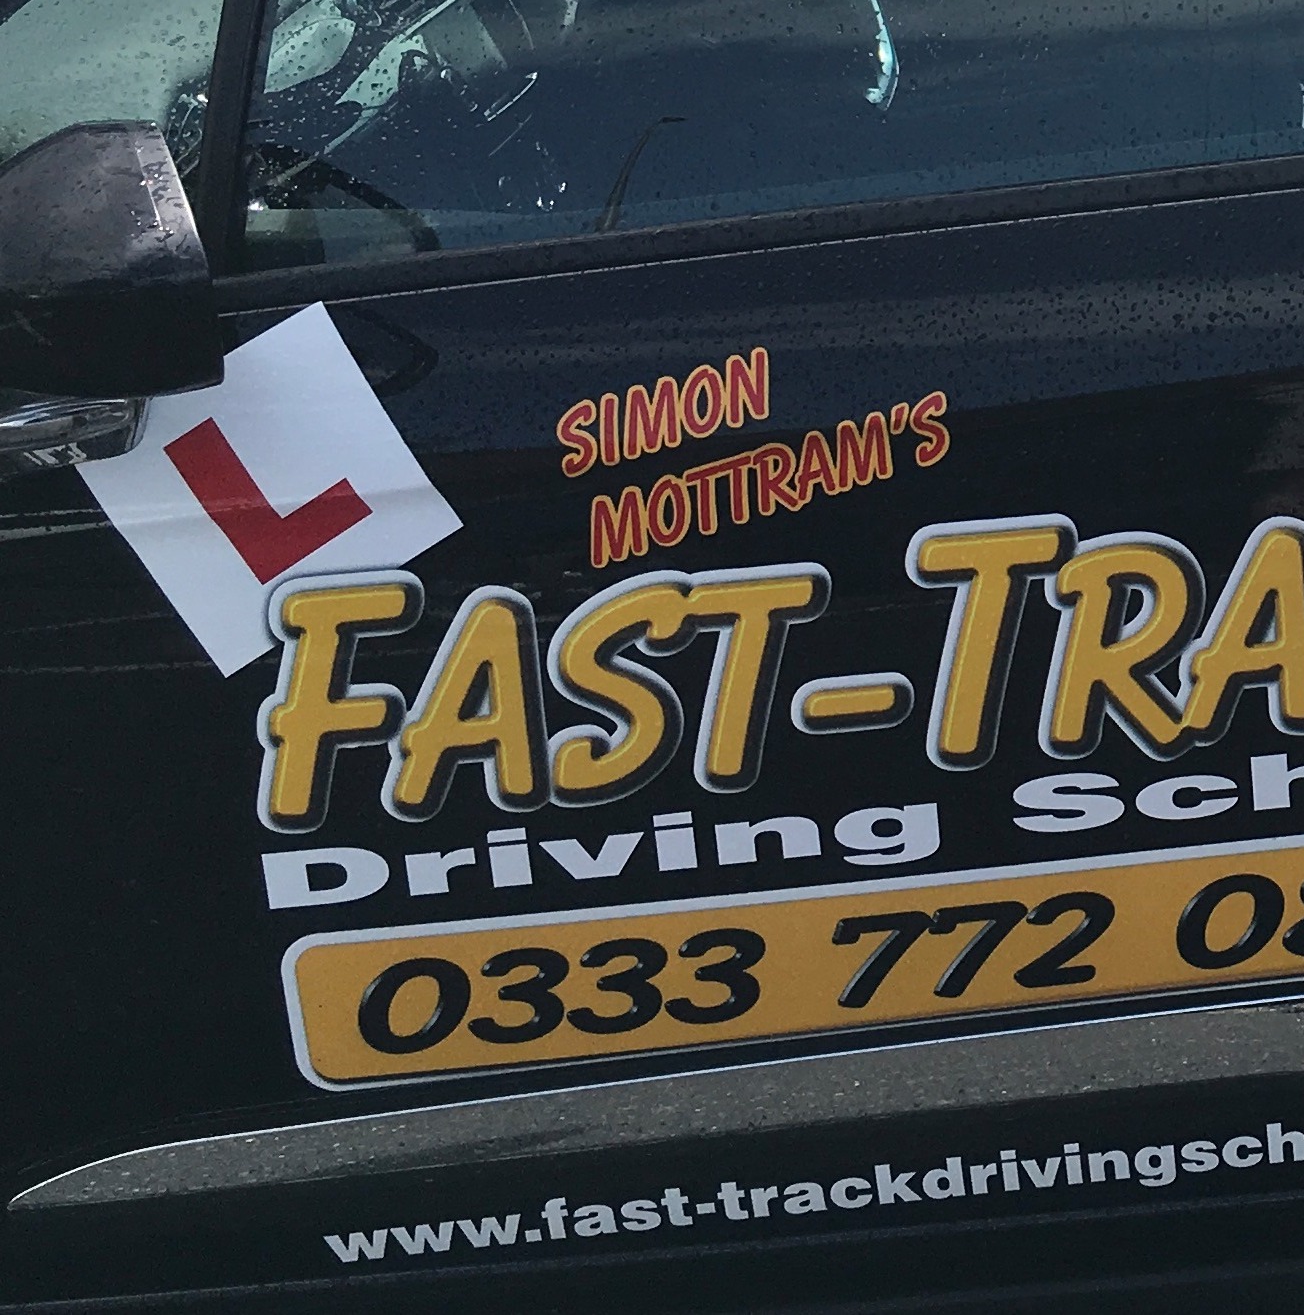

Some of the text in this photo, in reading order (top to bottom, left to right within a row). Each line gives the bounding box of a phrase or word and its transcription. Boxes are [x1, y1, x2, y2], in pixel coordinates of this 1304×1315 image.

[557, 346, 769, 478] SIMON
[591, 391, 950, 568] MOTTRAM'S
[163, 417, 373, 585] L
[261, 802, 940, 909] Driving
[357, 928, 766, 1055] 0333
[832, 892, 1115, 1008] 772
